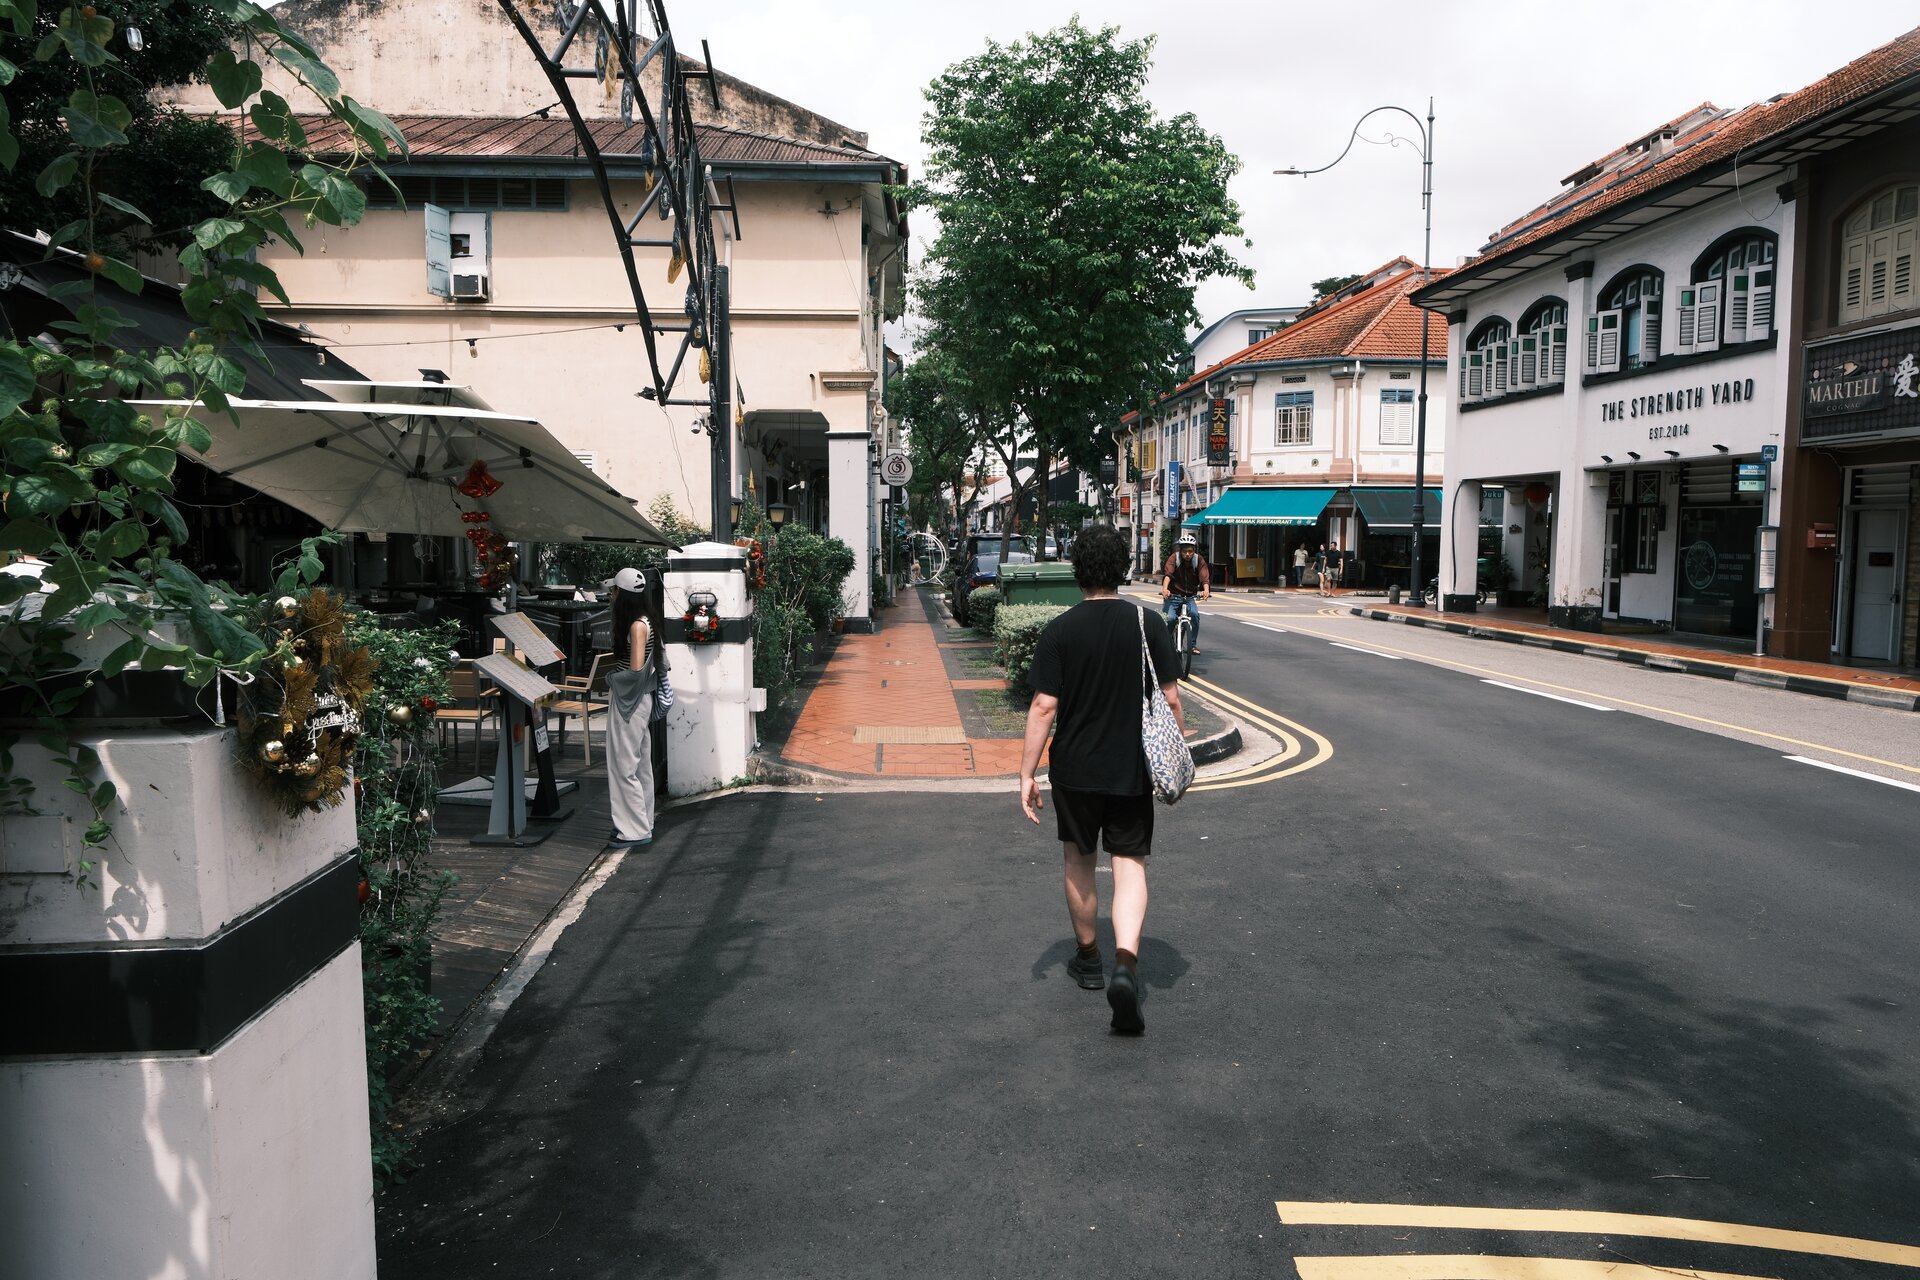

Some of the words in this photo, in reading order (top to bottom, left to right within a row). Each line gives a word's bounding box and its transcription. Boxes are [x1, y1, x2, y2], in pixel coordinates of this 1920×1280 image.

[1601, 400, 1624, 422] THE
[1630, 386, 1704, 418] STRENGTH
[1711, 378, 1754, 405] YARD
[1809, 377, 1881, 404] MARTELL
[1826, 402, 1861, 412] COGNAC
[1211, 407, 1228, 436] 天皇
[1649, 424, 1690, 440] EST.2014
